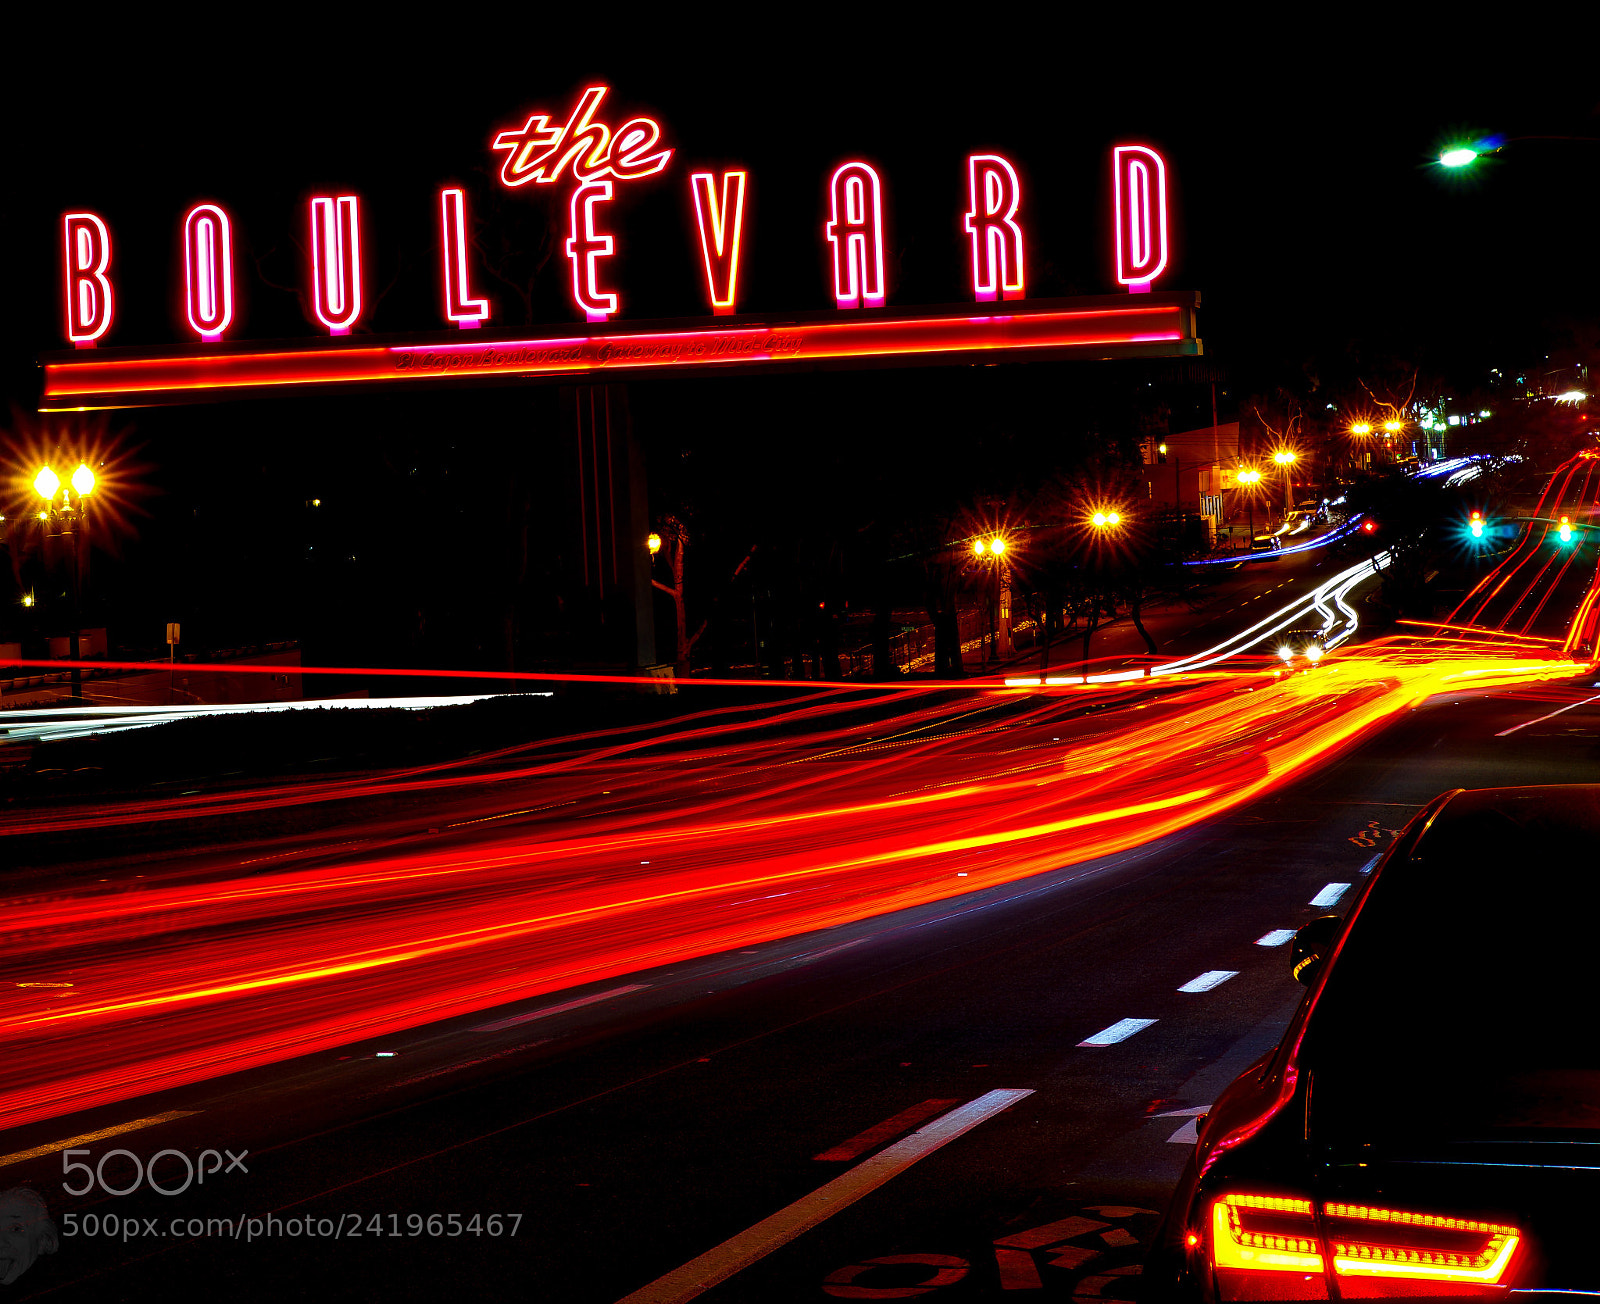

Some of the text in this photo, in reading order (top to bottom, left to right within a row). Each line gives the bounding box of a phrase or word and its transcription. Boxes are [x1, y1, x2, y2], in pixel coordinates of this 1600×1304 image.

[492, 85, 673, 188] the
[63, 144, 1169, 342] BOULEVARD
[395, 334, 803, 374] El Cajon Boulevard Gateway to Mid-City
